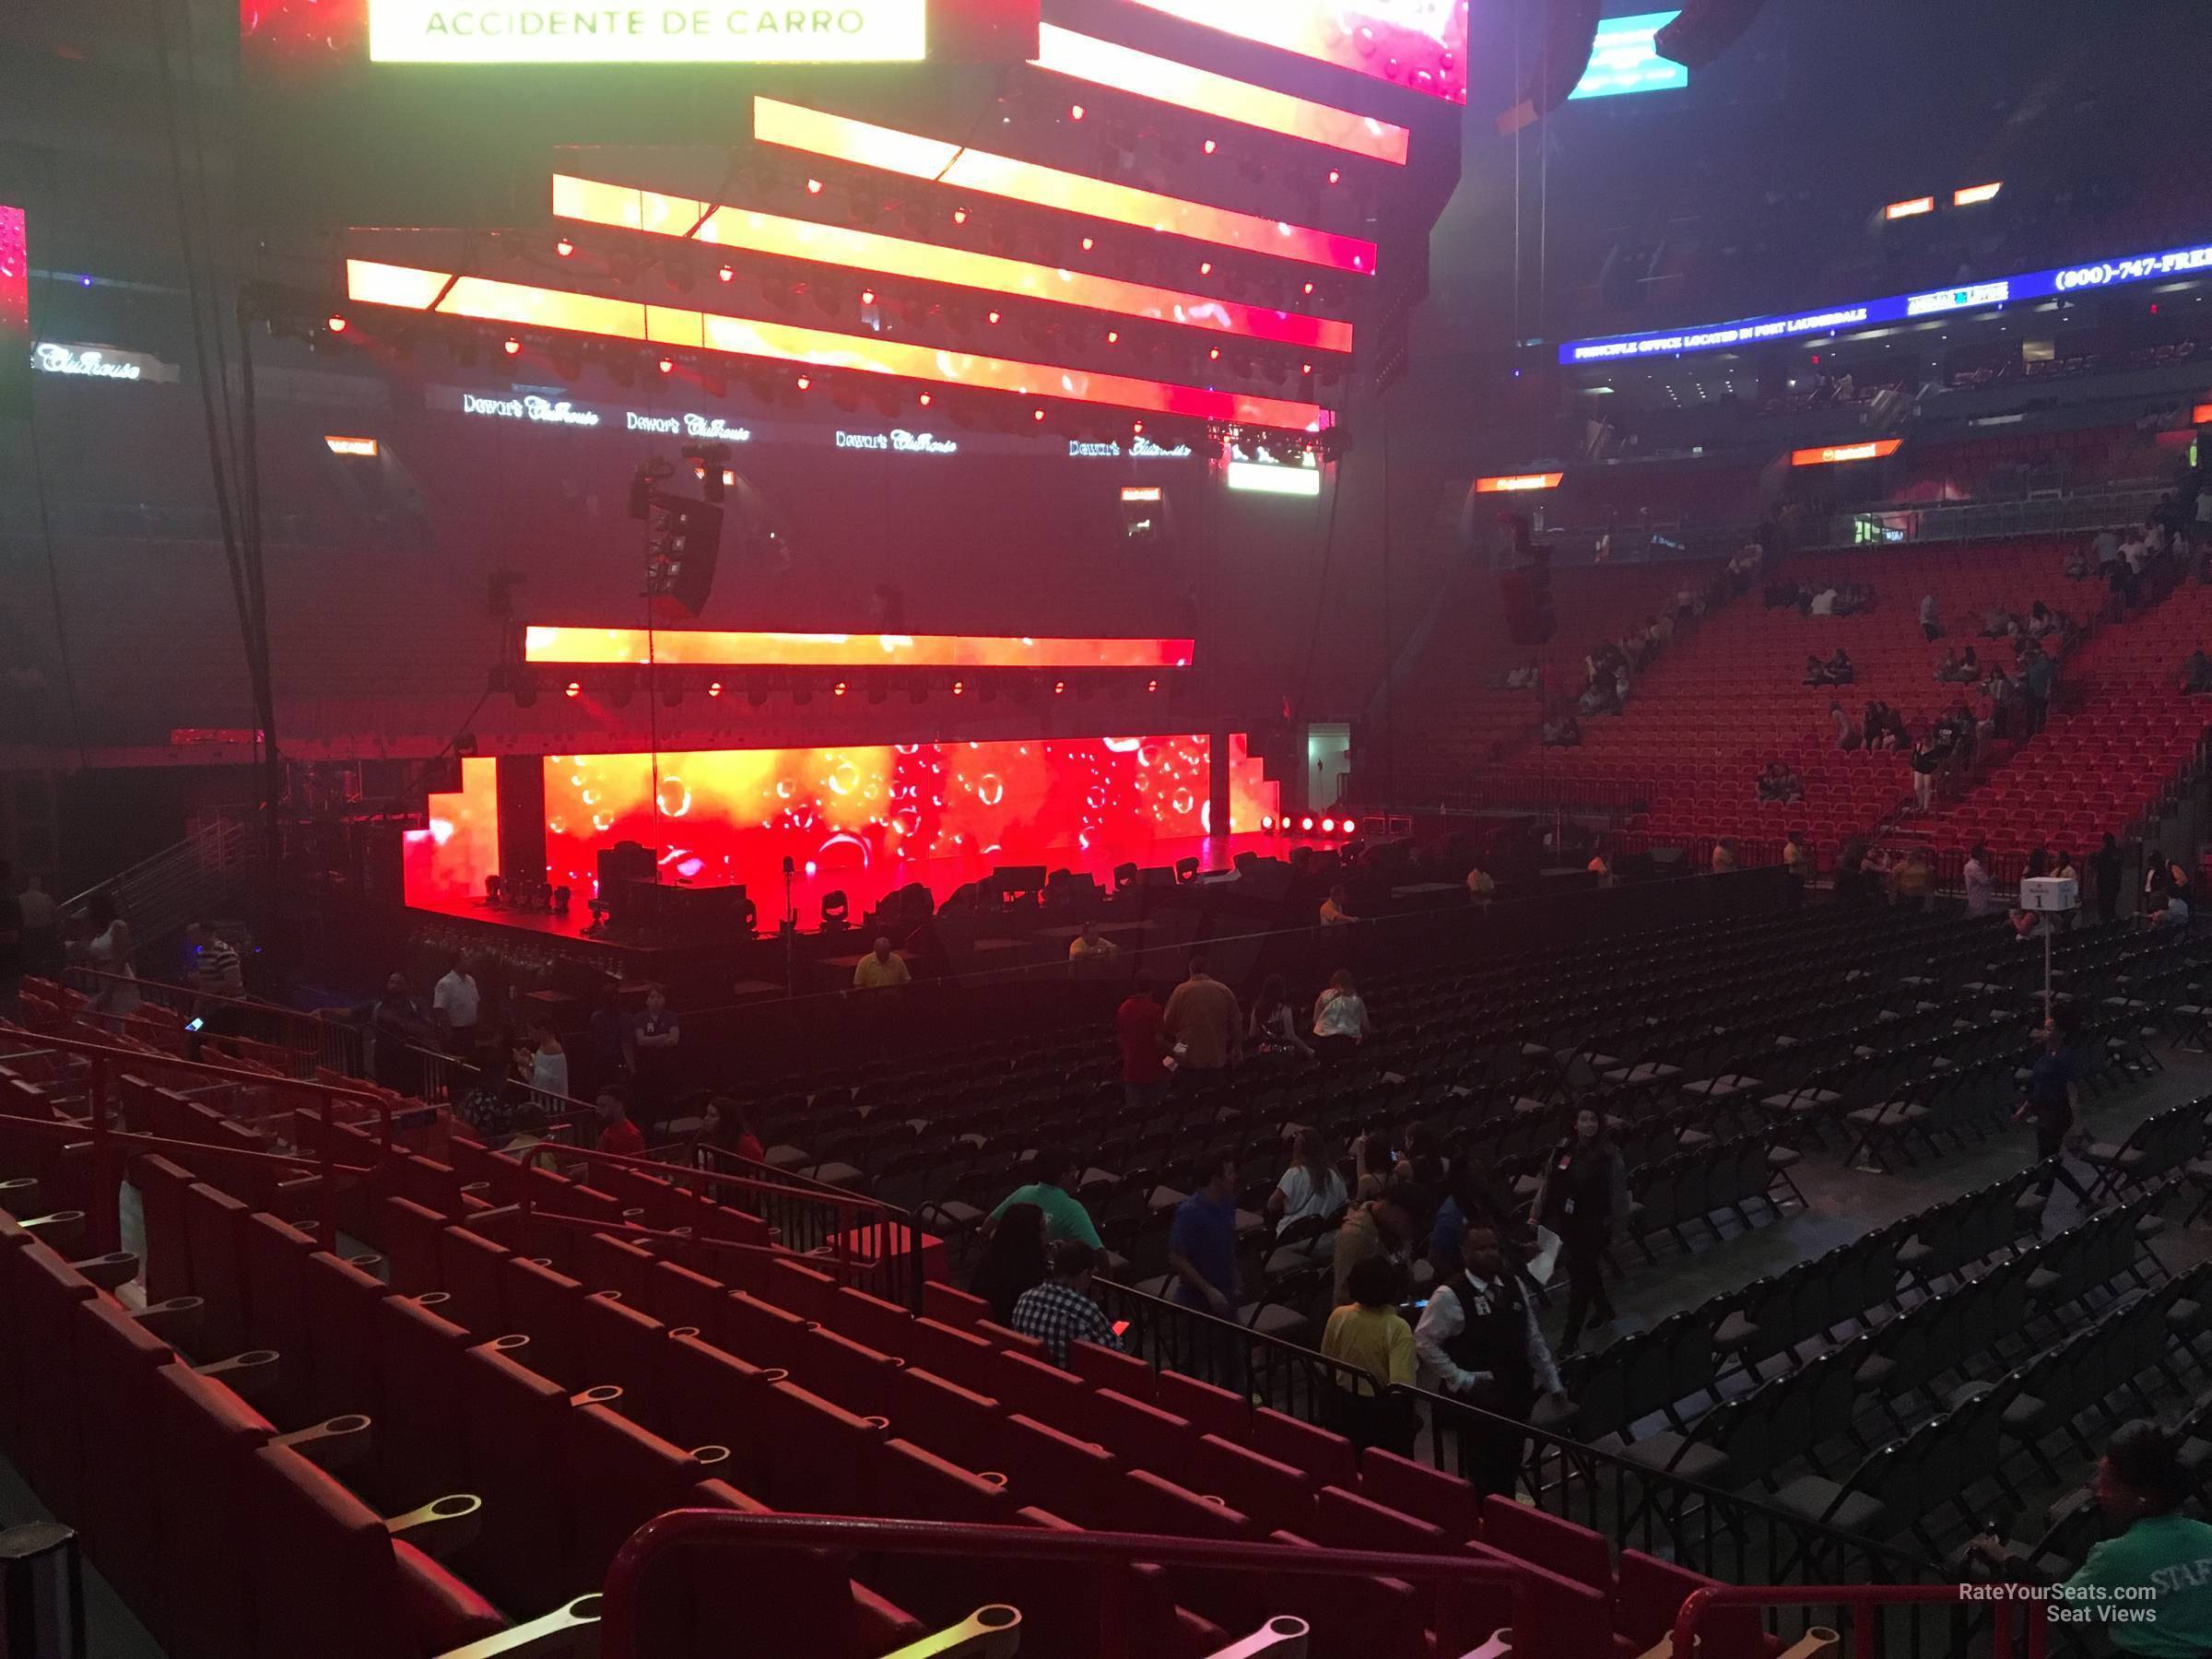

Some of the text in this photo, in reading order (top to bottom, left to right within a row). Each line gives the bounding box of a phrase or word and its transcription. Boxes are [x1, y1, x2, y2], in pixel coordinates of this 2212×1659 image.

[426, 7, 865, 36] ACCIDENTE DE CARRO
[1684, 331, 1738, 347] LOCATED
[1739, 327, 1753, 340] IN
[1755, 322, 1786, 336] FORT
